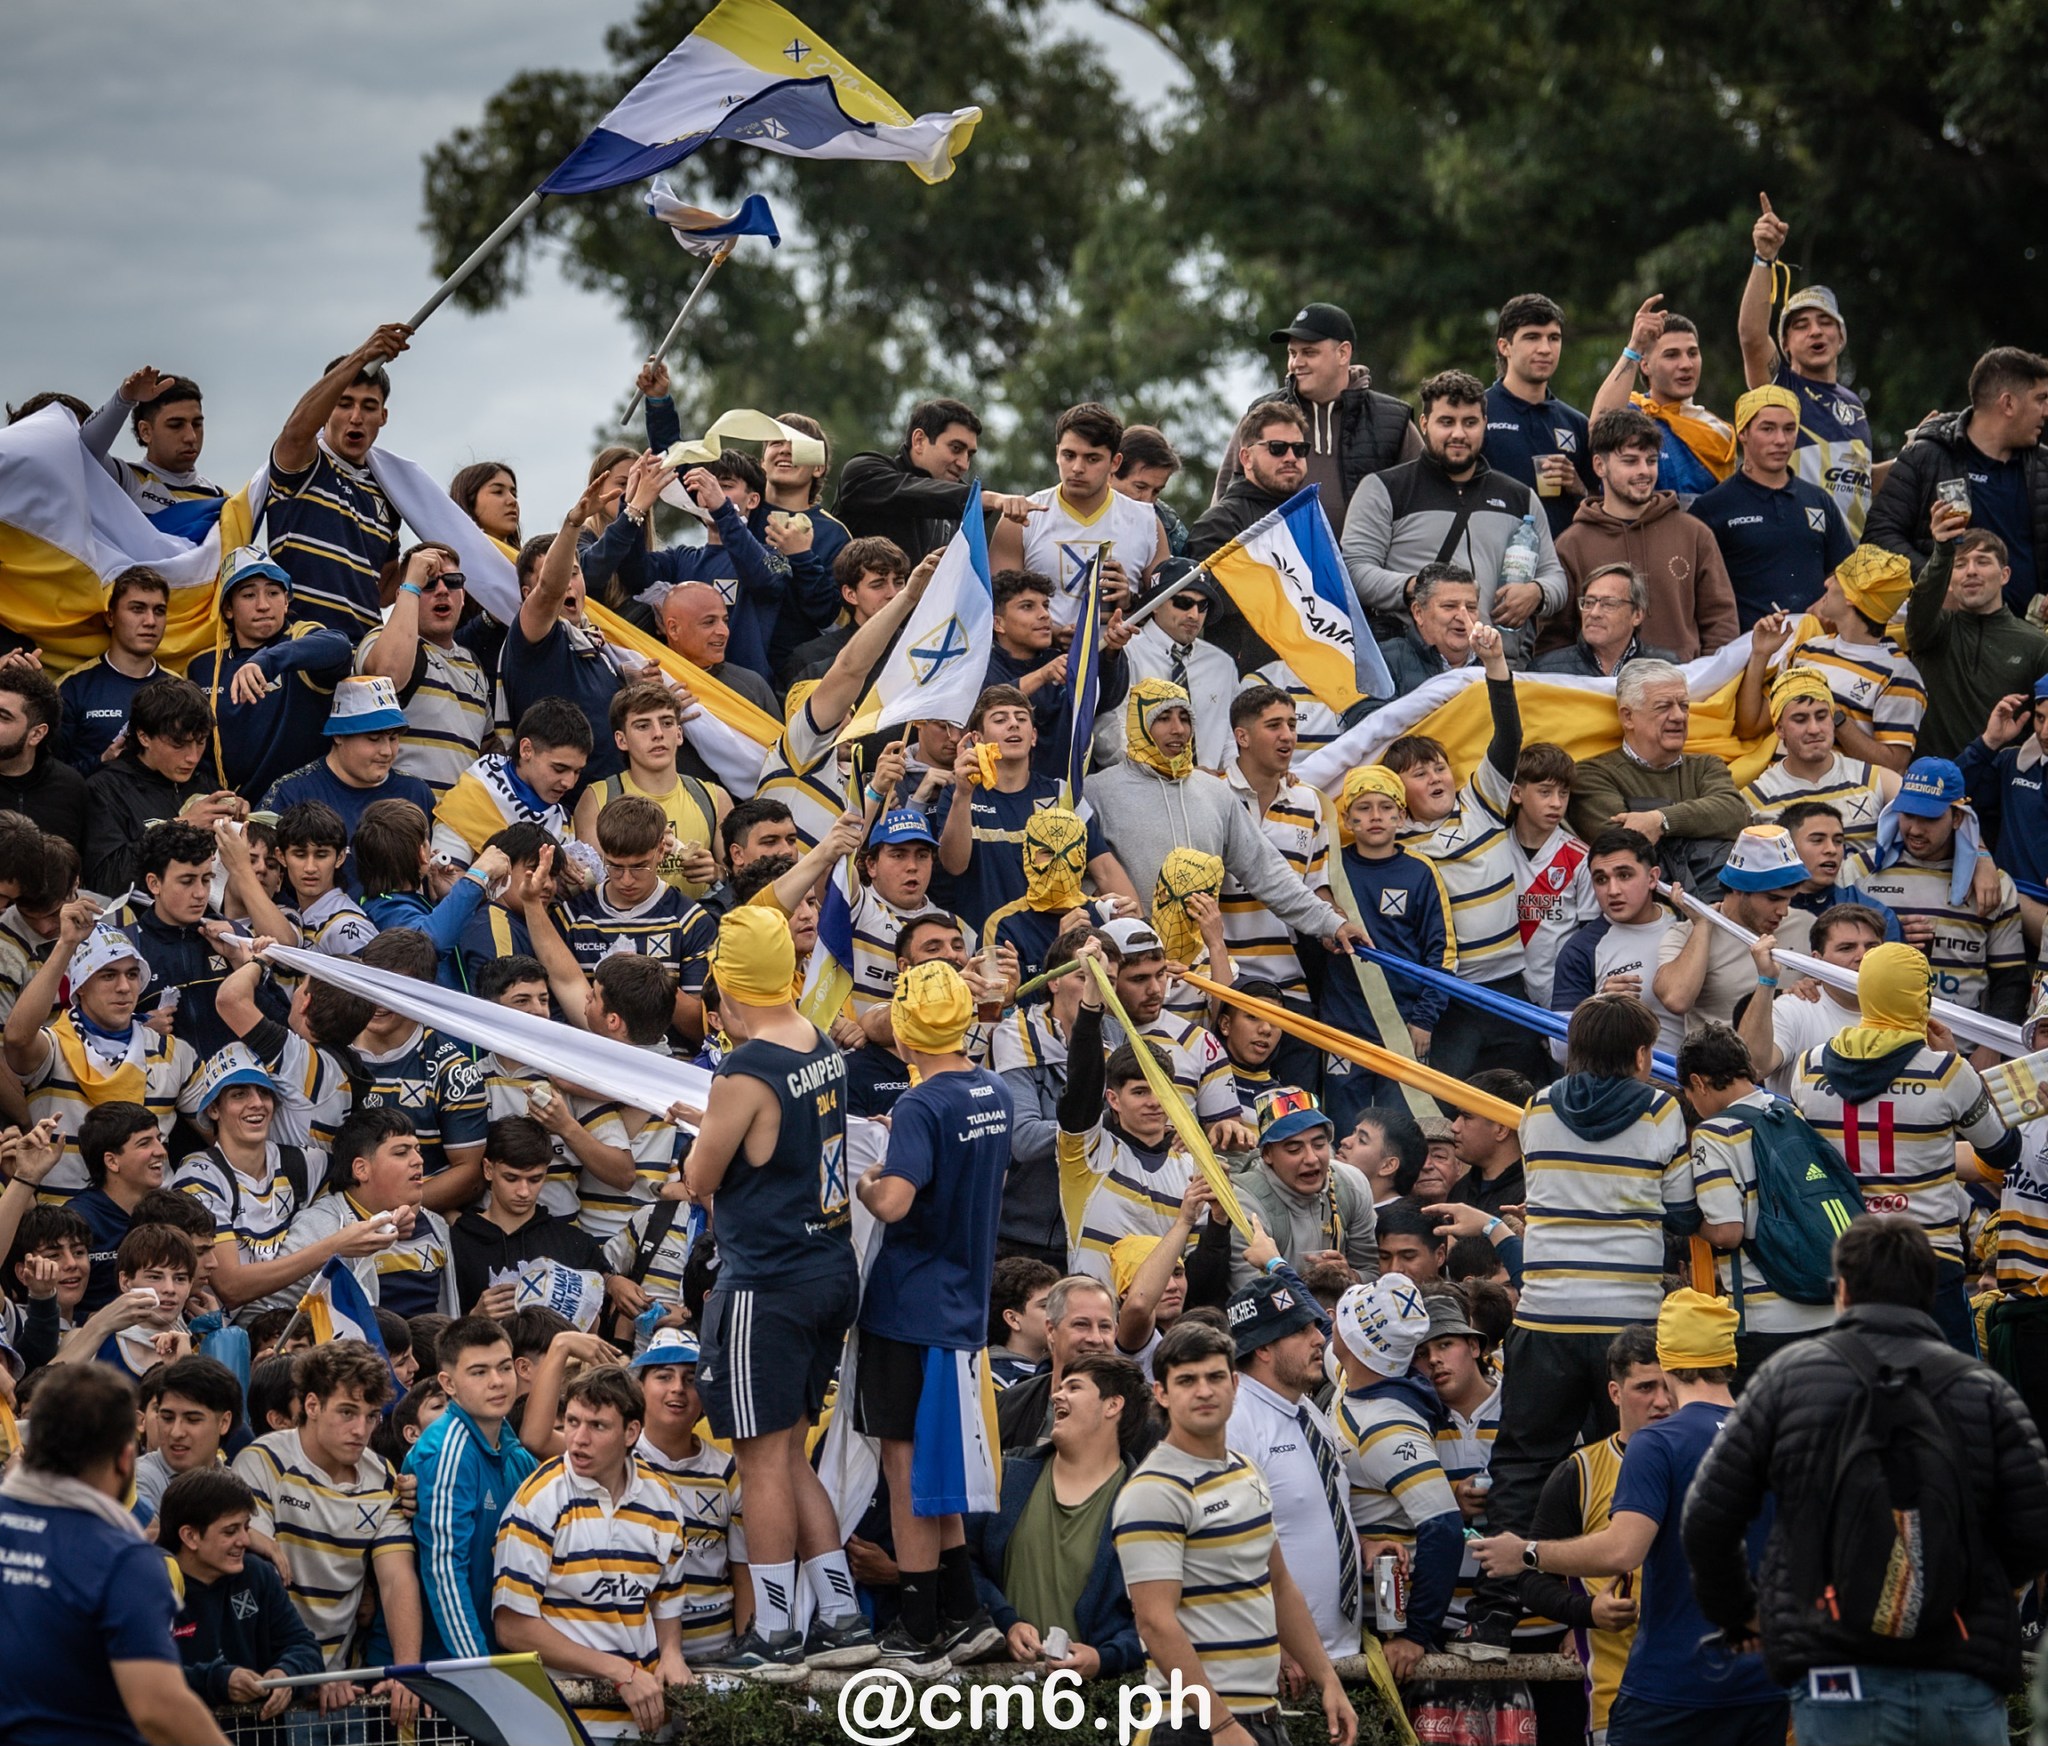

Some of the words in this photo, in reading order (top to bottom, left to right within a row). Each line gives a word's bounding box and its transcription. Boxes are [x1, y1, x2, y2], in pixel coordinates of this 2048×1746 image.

[86, 709, 122, 720] PROCER
[1905, 773, 1928, 782] TEAM
[887, 813, 914, 824] TEAM
[1868, 885, 1904, 895] PROCER
[1518, 894, 1562, 907] RKISH
[1607, 960, 1644, 977] PROCER
[874, 1082, 909, 1092] PROCER
[1843, 1101, 1895, 1174] 11
[1370, 1308, 1389, 1329] LOS
